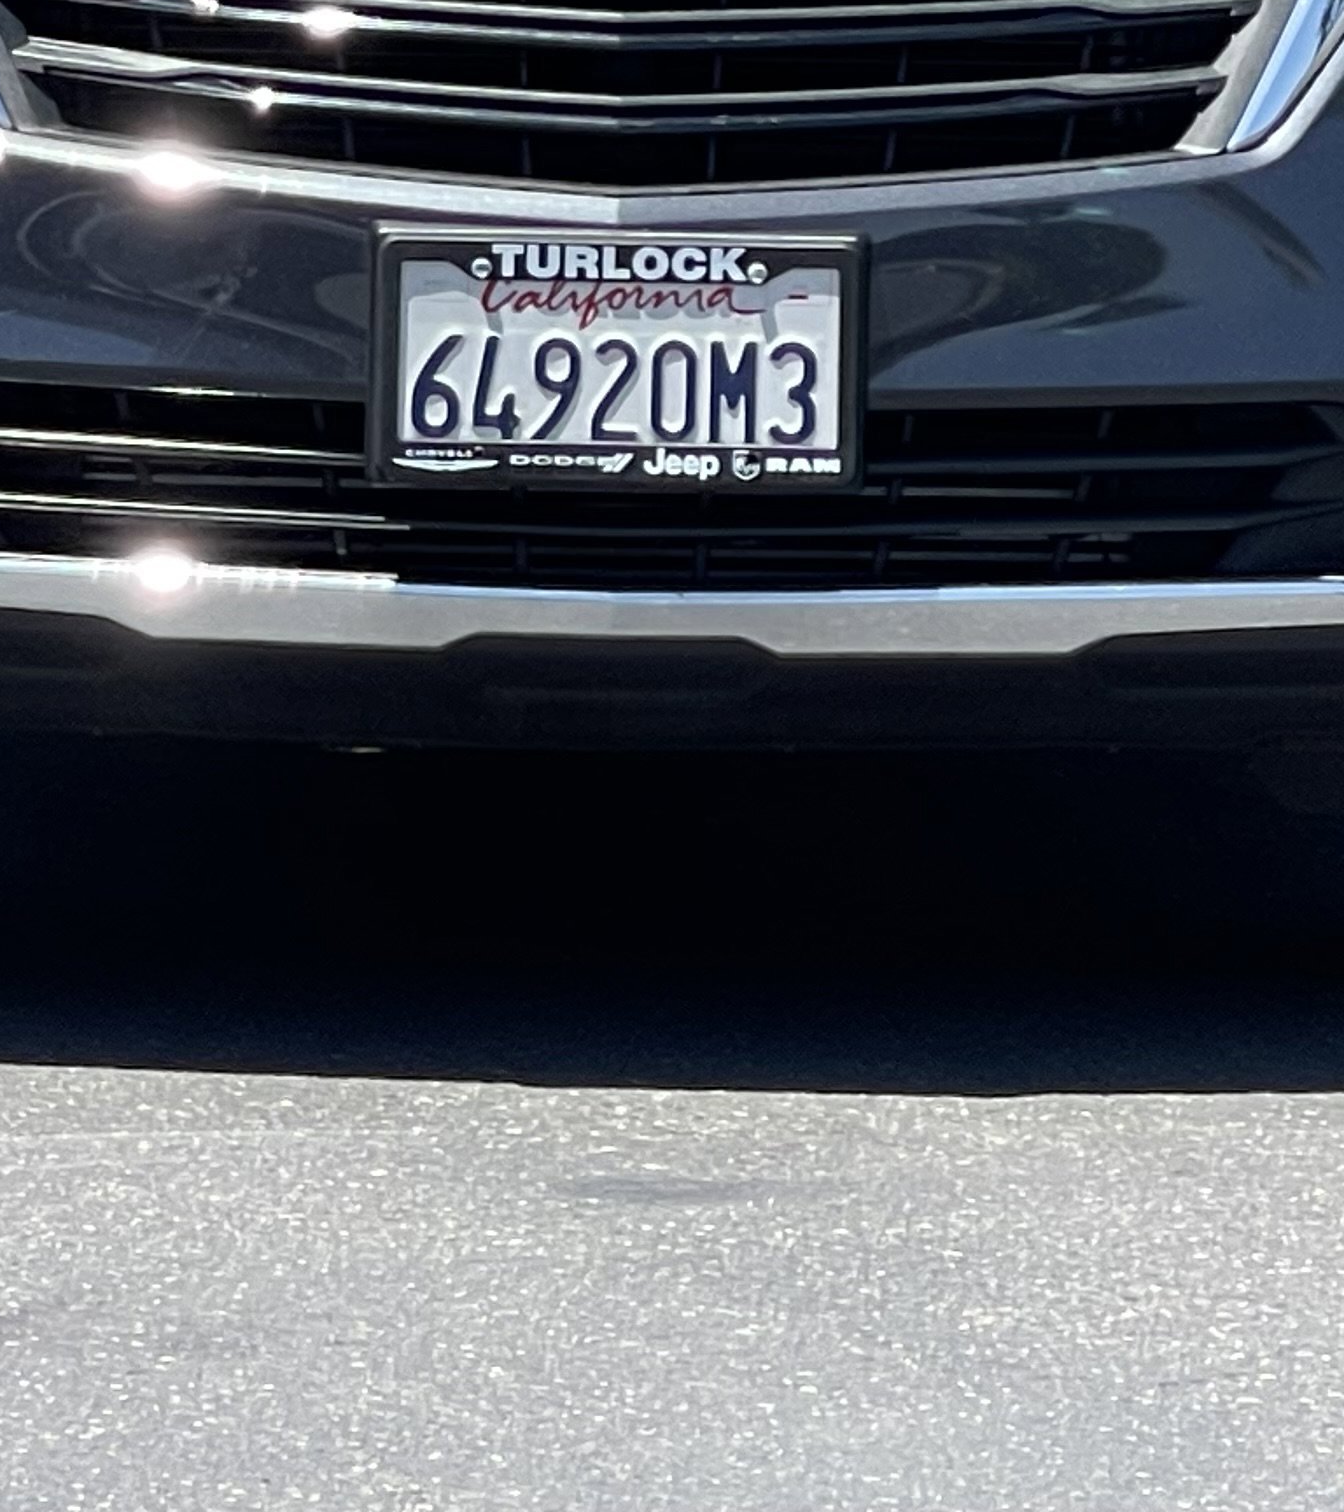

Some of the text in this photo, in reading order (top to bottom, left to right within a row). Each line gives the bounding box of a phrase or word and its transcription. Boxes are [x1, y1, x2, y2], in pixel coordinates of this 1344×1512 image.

[491, 244, 747, 282] TURLOCK
[481, 280, 767, 330] California
[410, 333, 819, 446] 64920M3
[642, 447, 721, 481] Jeep
[765, 457, 842, 474] RAM
